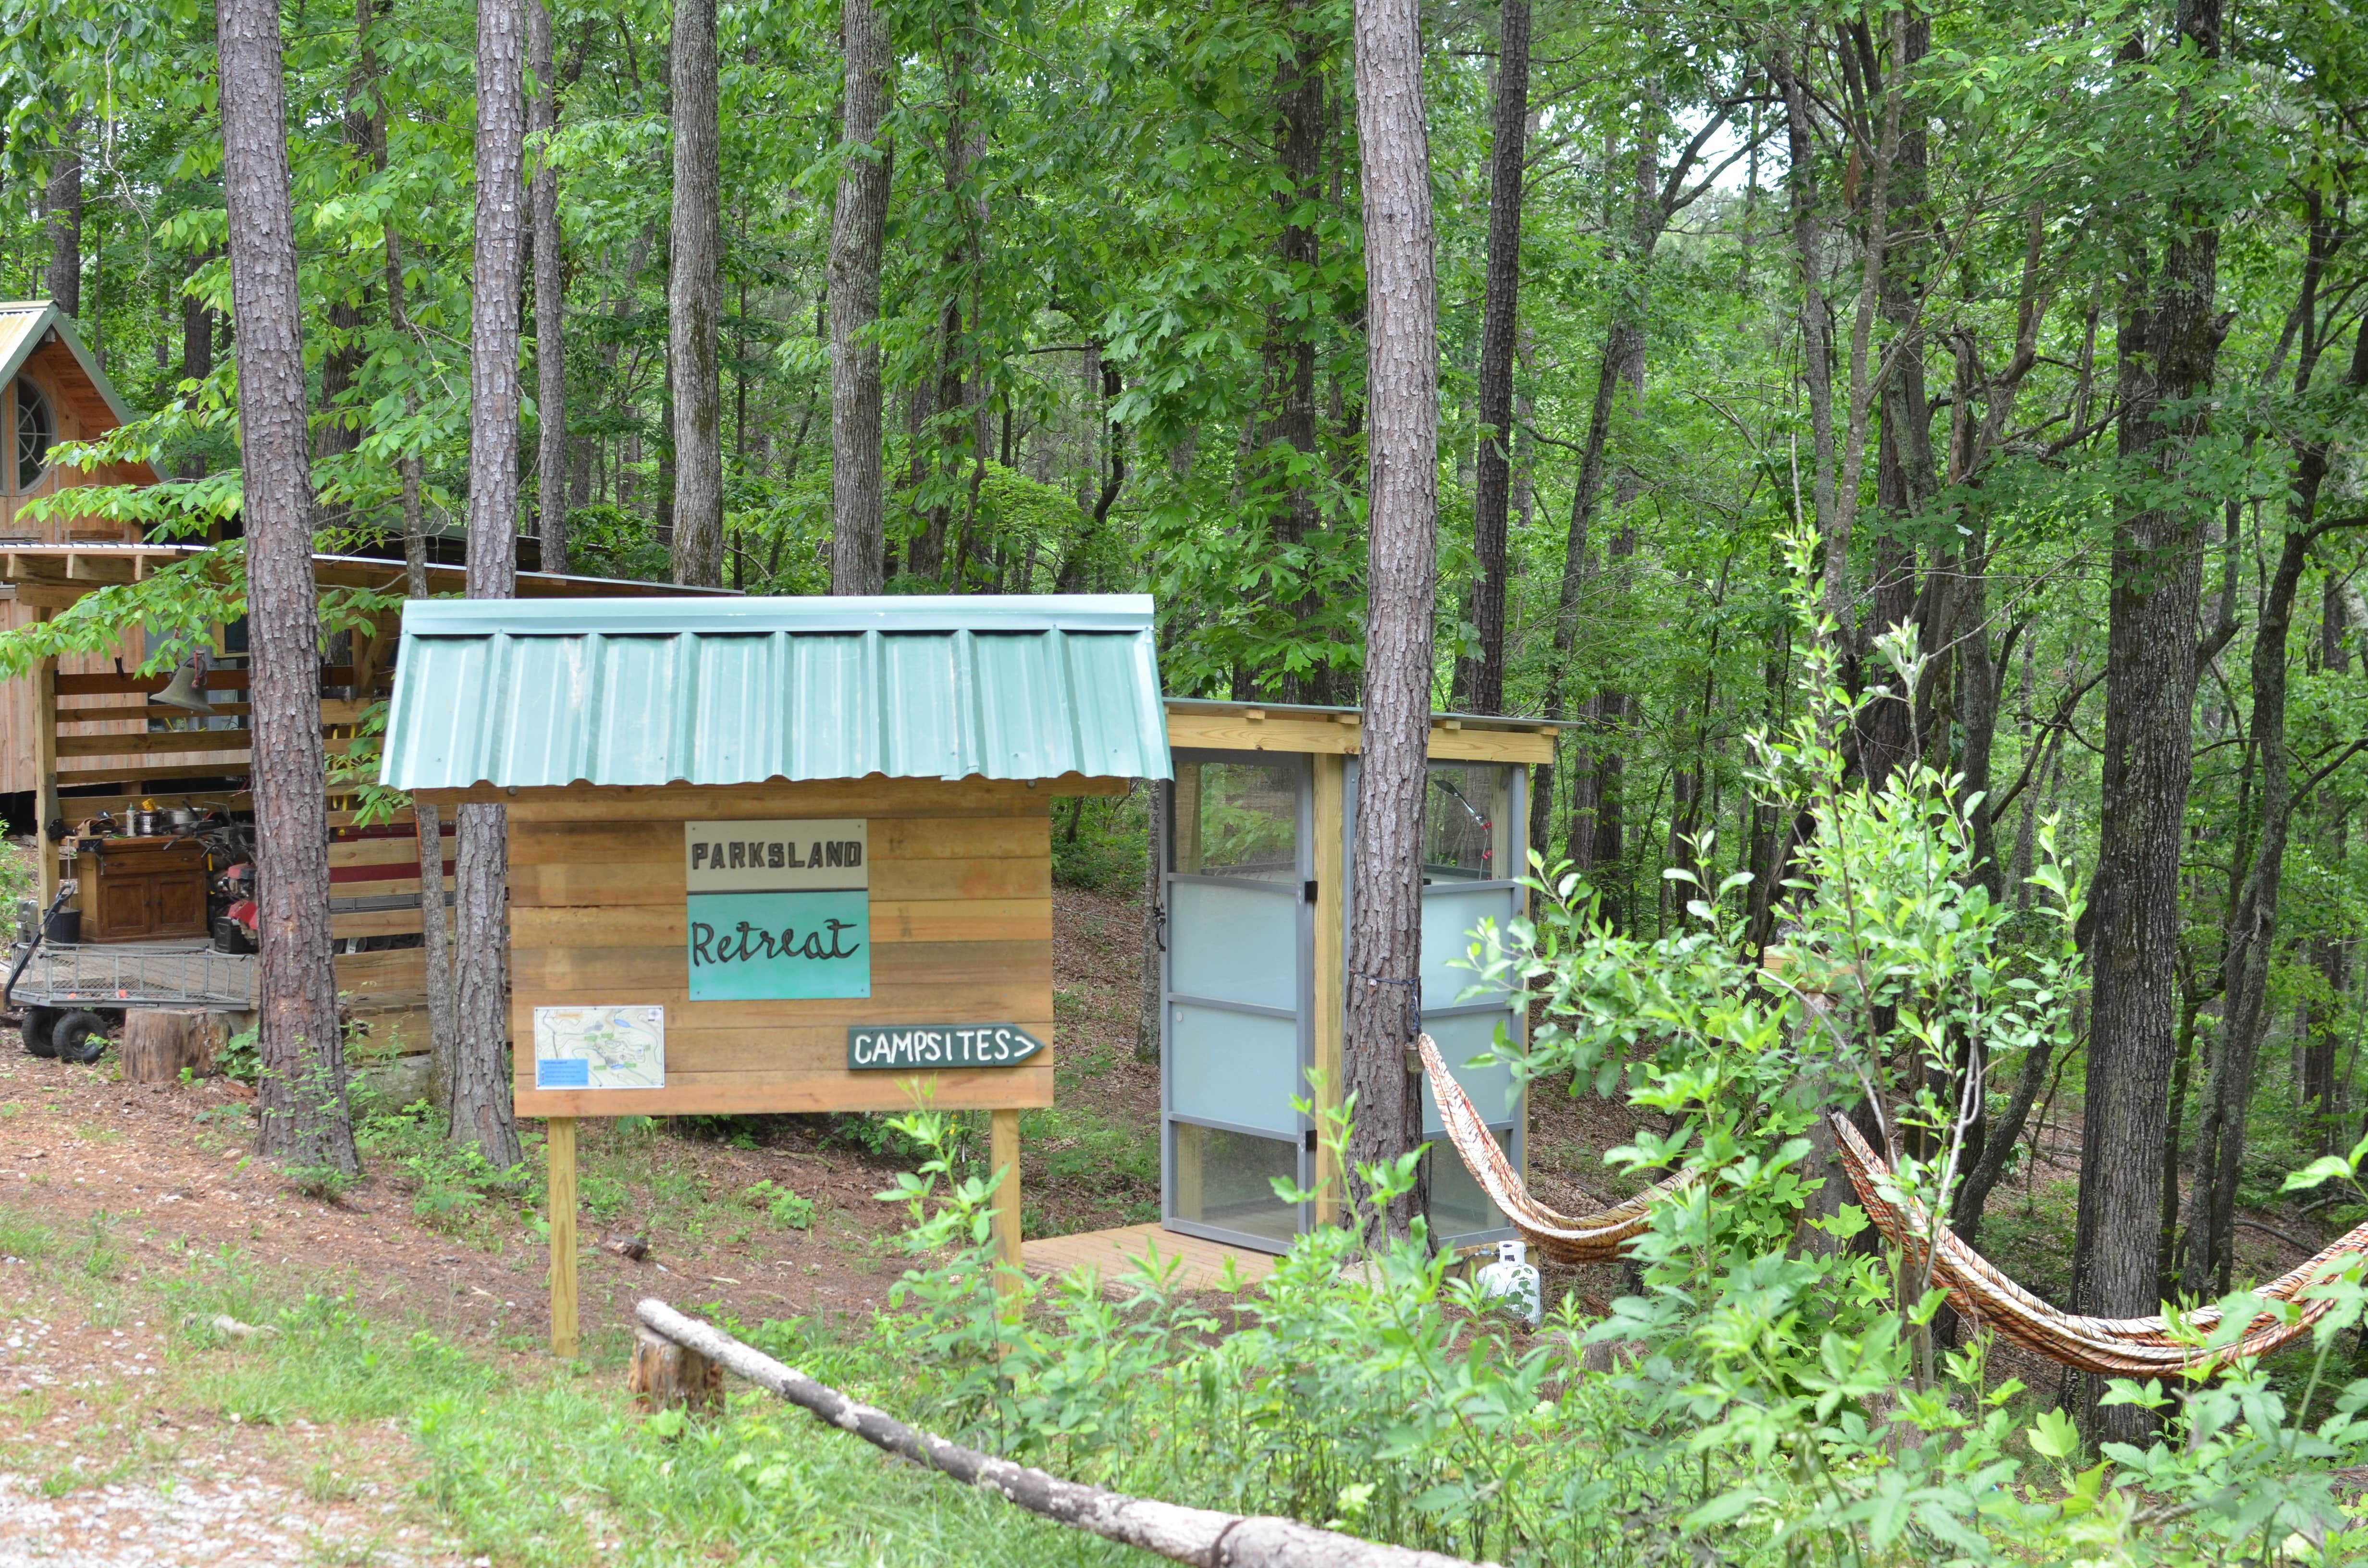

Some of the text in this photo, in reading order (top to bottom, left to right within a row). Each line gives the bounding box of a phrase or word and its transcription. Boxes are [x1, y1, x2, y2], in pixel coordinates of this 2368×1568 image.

[692, 841, 862, 870] PARKSLAND
[691, 918, 861, 967] Retreat
[854, 1029, 1011, 1064] CAMPSITES
